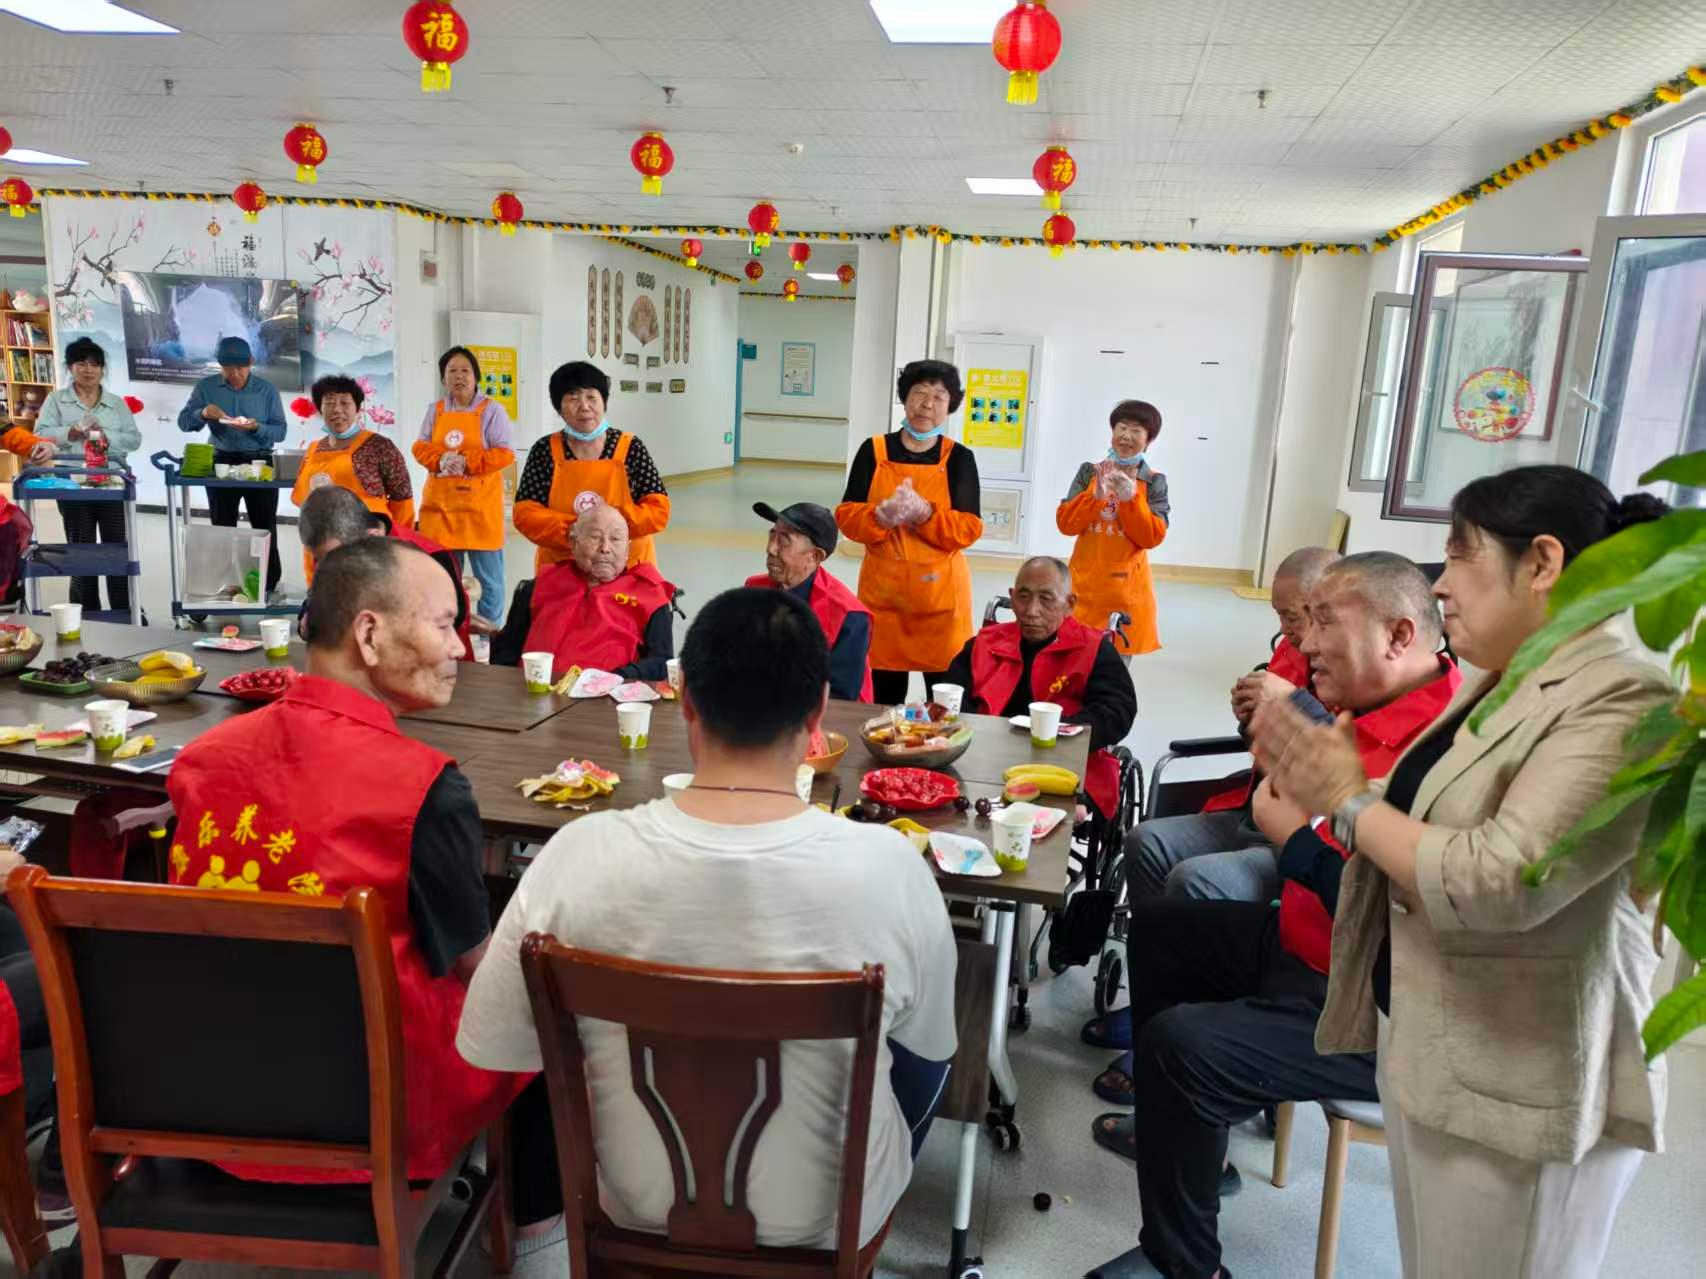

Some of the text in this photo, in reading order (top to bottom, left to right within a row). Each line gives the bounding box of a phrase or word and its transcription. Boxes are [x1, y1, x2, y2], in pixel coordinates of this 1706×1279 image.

[420, 12, 459, 52] 福
[299, 136, 324, 160] 福
[640, 143, 663, 169] 福
[1052, 157, 1074, 184] 福
[1, 184, 18, 201] 福
